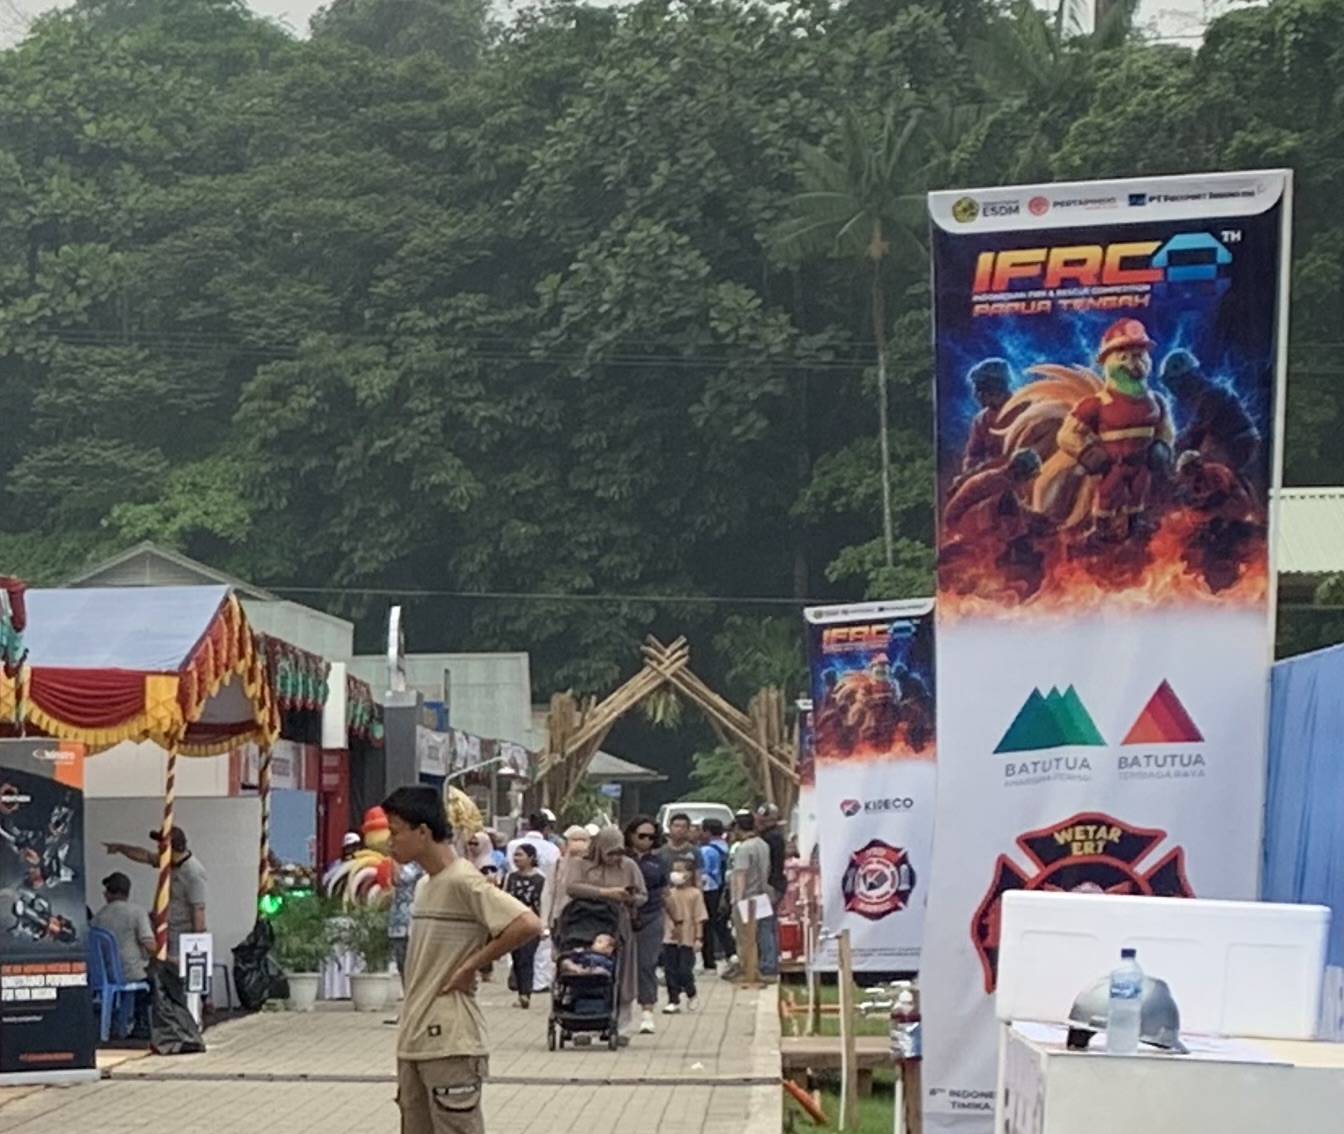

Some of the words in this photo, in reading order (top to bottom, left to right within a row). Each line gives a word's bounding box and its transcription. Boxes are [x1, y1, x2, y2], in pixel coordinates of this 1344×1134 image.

[972, 240, 1164, 293] IFRC
[1004, 757, 1092, 778] BATUTUA
[1117, 753, 1206, 770] BATUTUA
[864, 797, 915, 812] KIDECO
[1053, 824, 1123, 844] WETAR
[1070, 840, 1106, 856] ERT
[948, 1088, 997, 1100] INDONE
